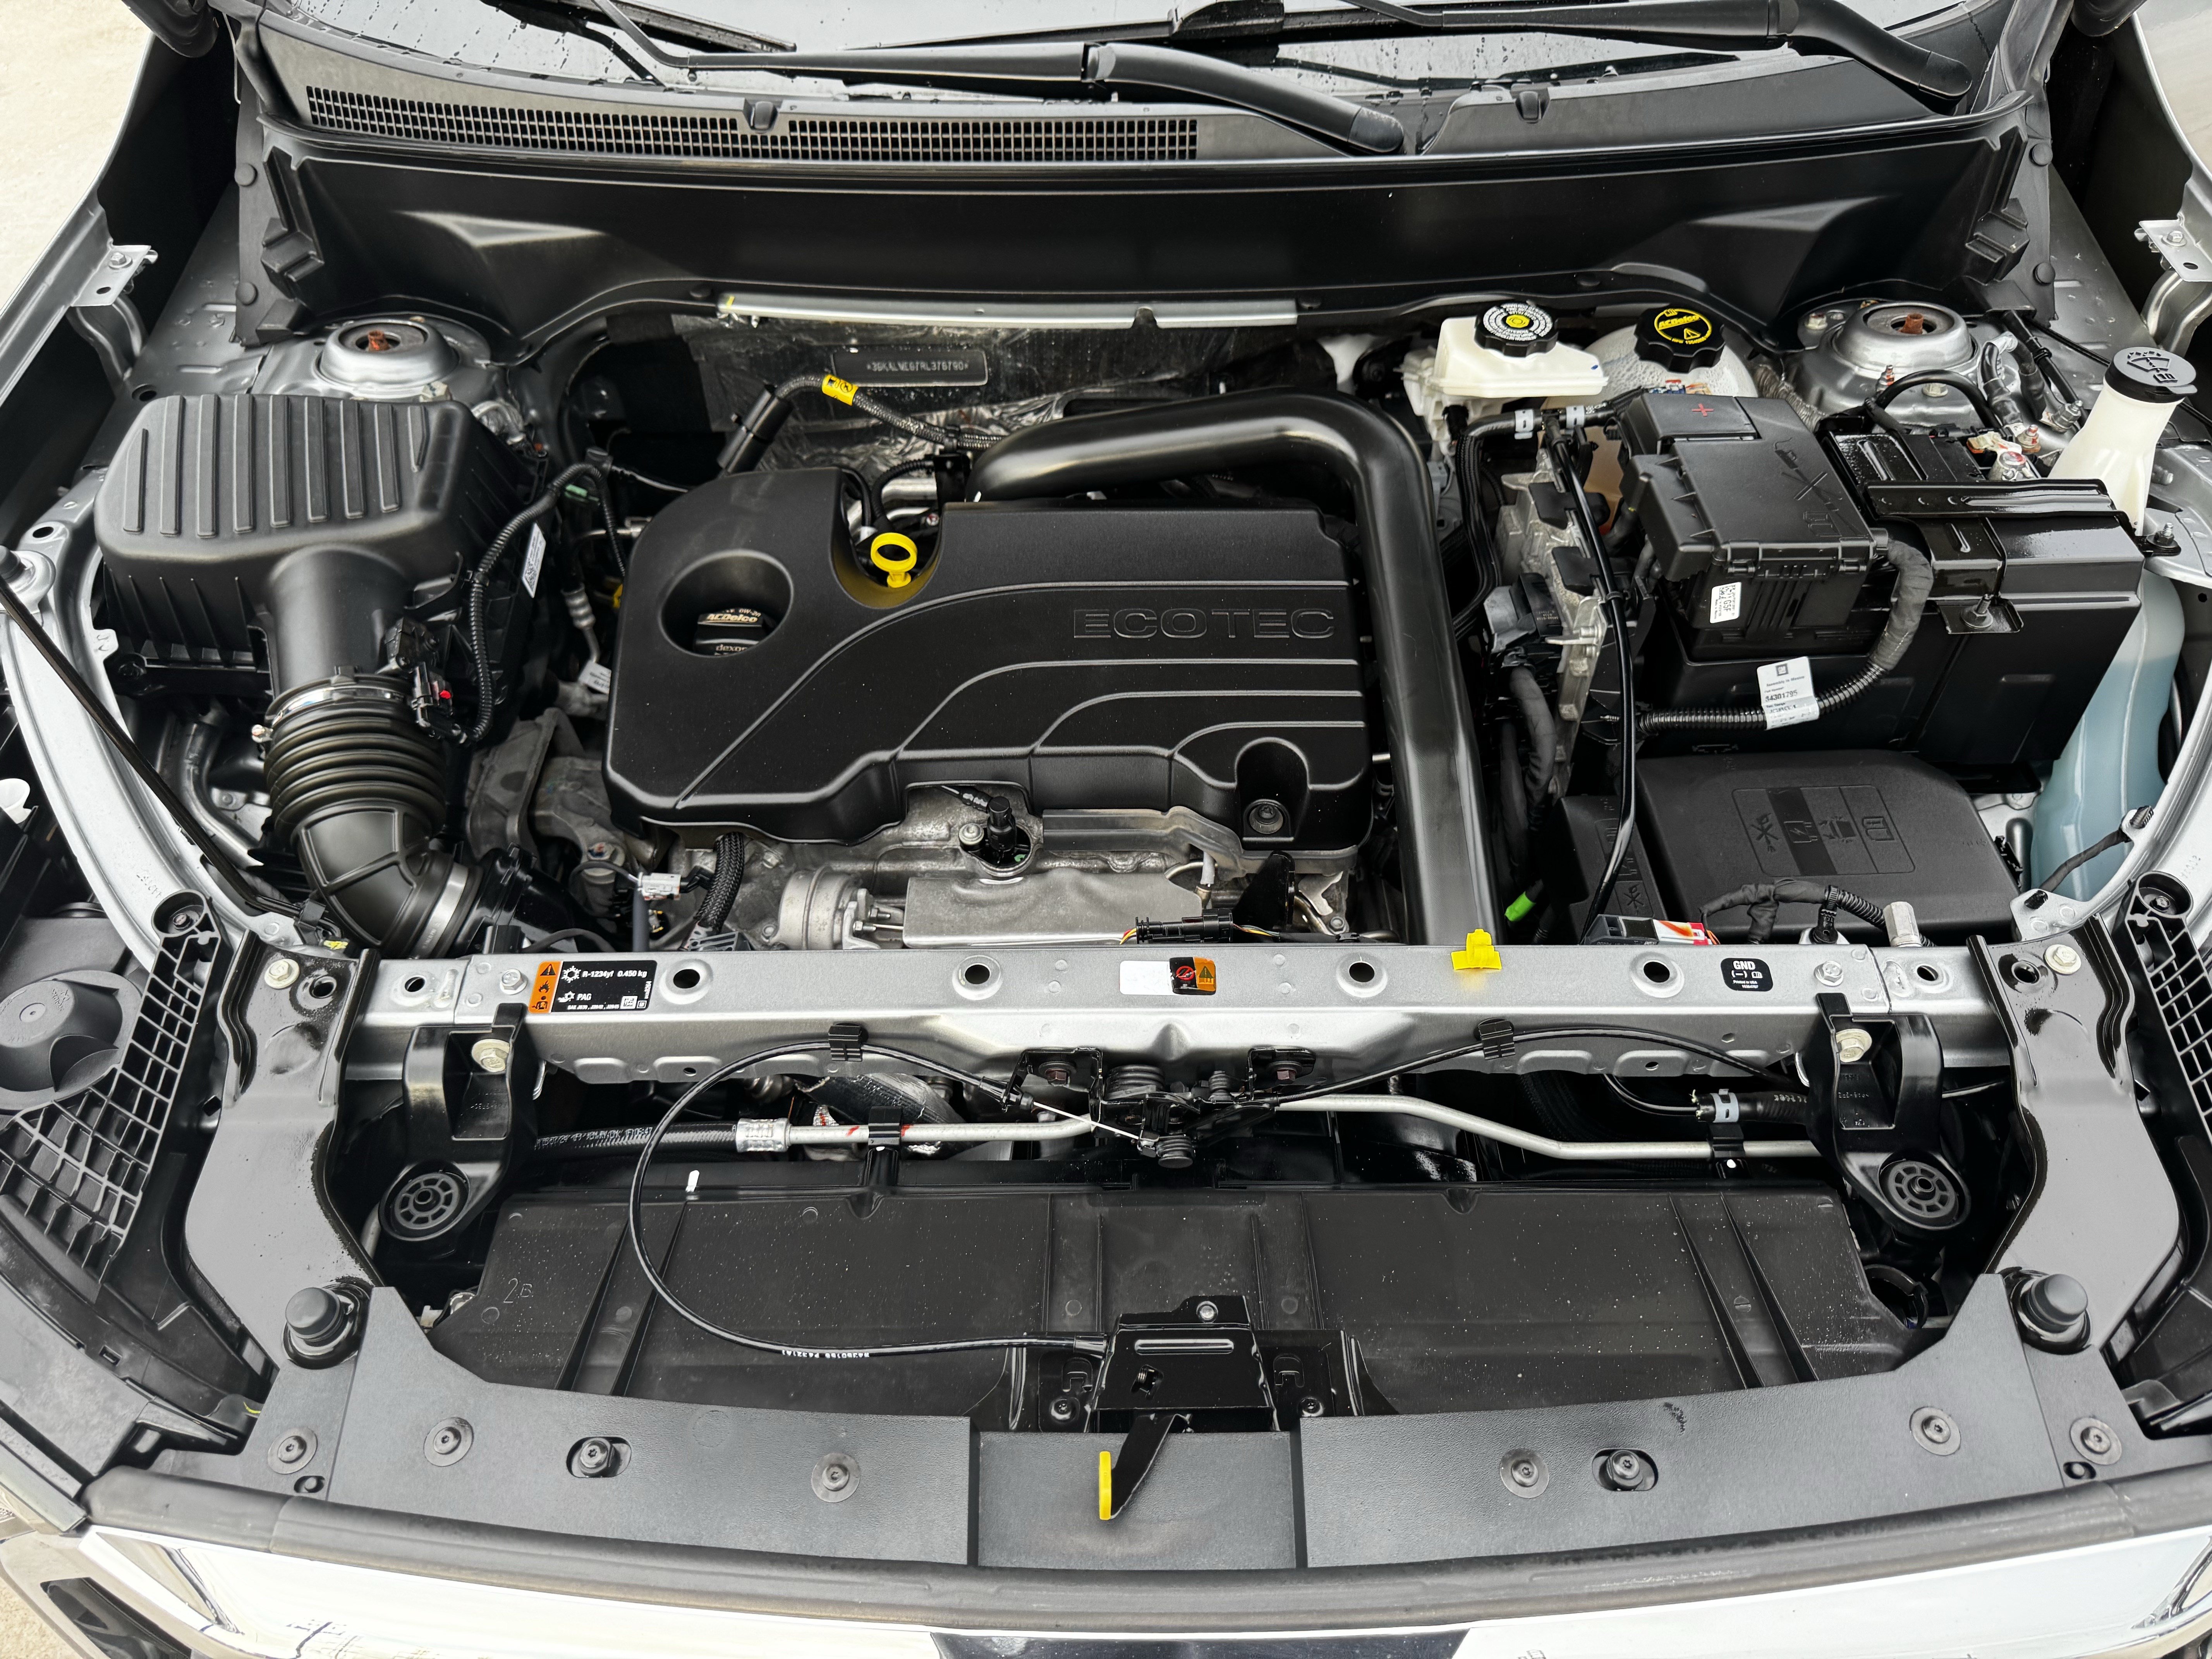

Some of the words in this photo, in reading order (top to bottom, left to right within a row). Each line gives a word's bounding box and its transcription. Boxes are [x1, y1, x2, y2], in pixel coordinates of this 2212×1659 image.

[1659, 315, 1700, 328] ACDelco
[706, 613, 758, 623] ACDelco
[1073, 608, 1334, 639] ECOTEC
[1733, 960, 1756, 970] GND
[581, 970, 615, 979] R-1234yf
